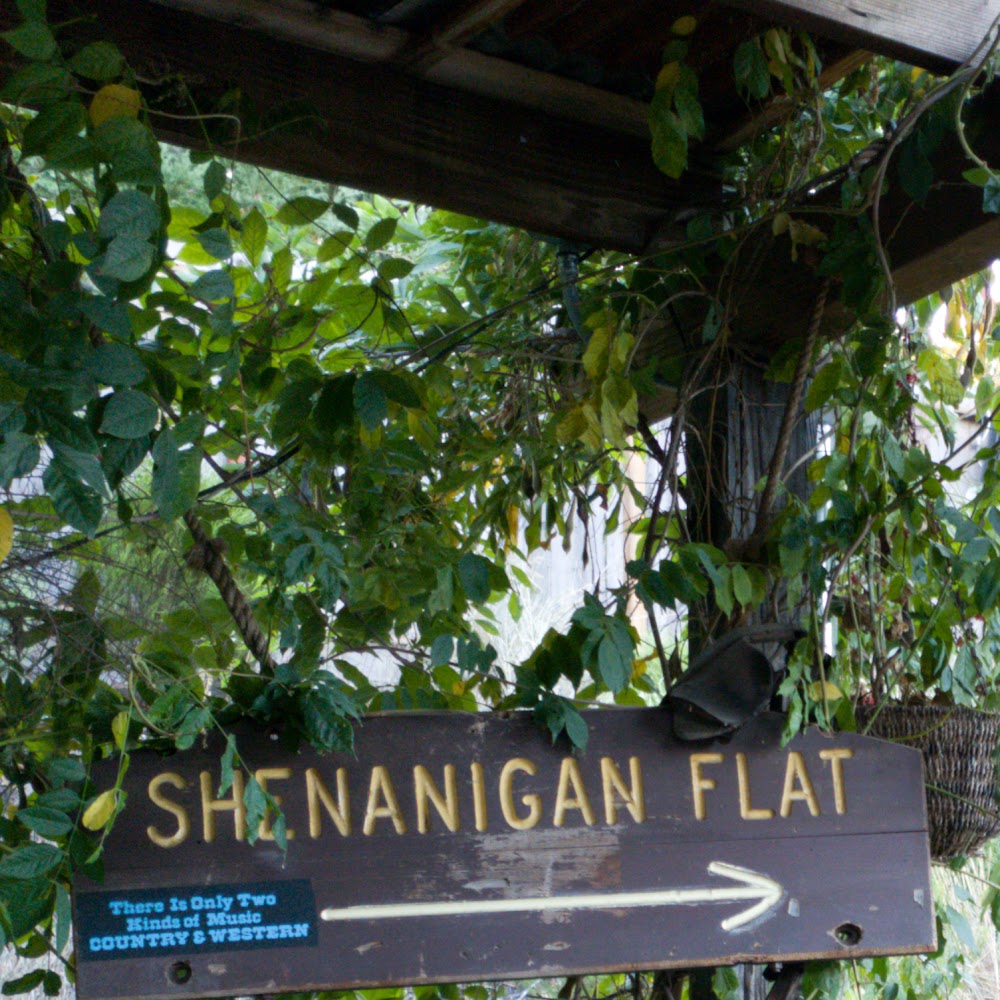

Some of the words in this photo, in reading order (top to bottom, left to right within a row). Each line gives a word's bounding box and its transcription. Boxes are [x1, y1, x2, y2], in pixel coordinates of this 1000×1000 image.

[146, 757, 645, 848] SHENANIGAN
[690, 748, 854, 820] FLAT
[109, 900, 165, 915] There
[169, 898, 188, 911] Is
[190, 895, 233, 911] Only
[237, 893, 277, 908] Two
[126, 916, 181, 932] Kinds
[183, 914, 200, 927] of
[206, 911, 262, 926] Music
[89, 931, 189, 951] COUNTRY
[193, 930, 206, 944] &
[208, 923, 309, 943] WESTERN
